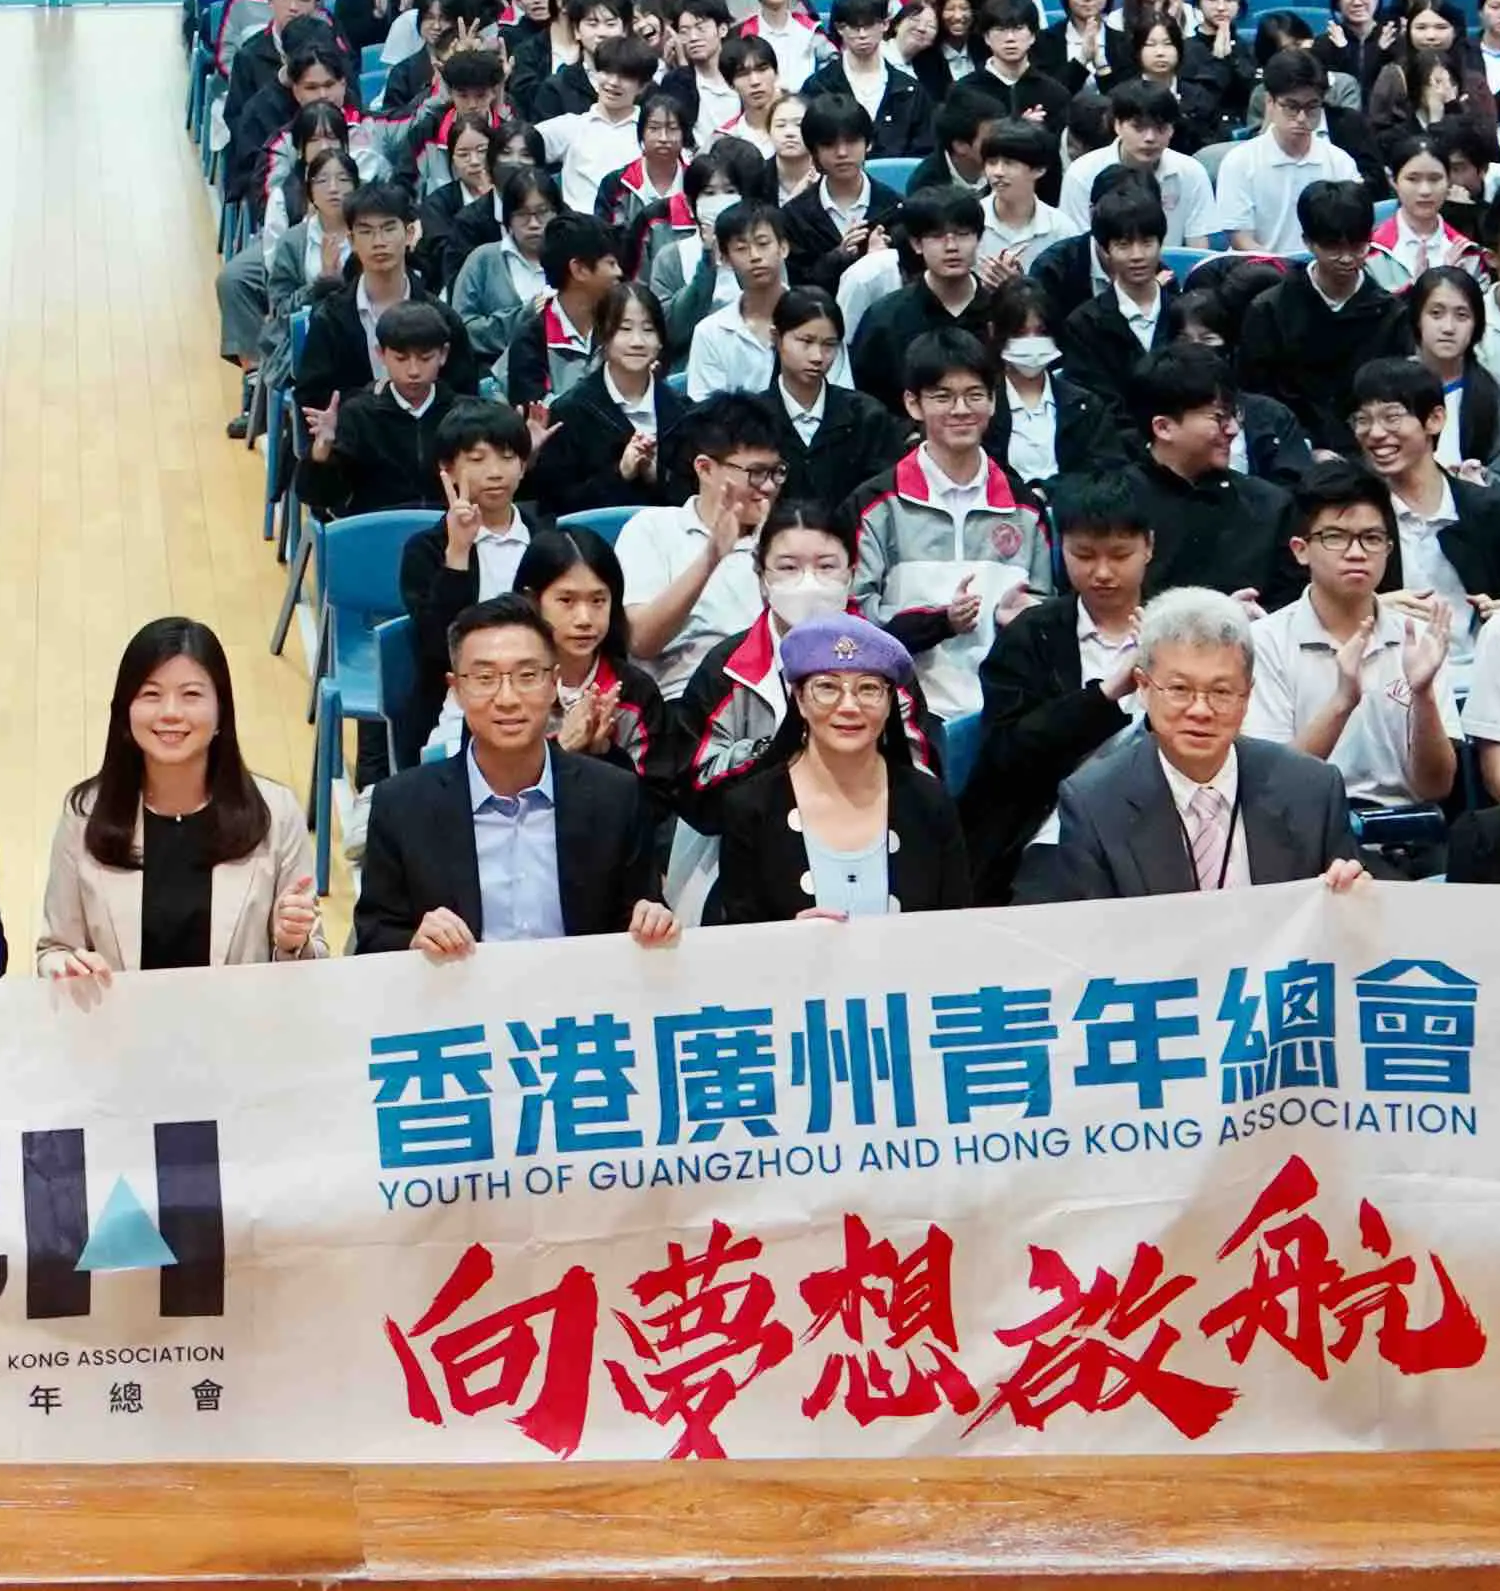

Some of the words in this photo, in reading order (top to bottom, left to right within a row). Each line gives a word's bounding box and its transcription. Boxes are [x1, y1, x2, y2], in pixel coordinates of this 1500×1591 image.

[368, 958, 1481, 1170] 香港廣州青年總會
[378, 1169, 511, 1212] YOUTH
[525, 1163, 575, 1196] OF
[588, 1145, 843, 1191] GUANGZHOU
[858, 1137, 940, 1173] AND
[955, 1127, 1070, 1167] HONG
[1084, 1117, 1202, 1155] KONG
[1218, 1096, 1478, 1147] ASSOCIATION
[7, 1351, 70, 1371] KONG
[77, 1345, 225, 1367] ASSOCIATION
